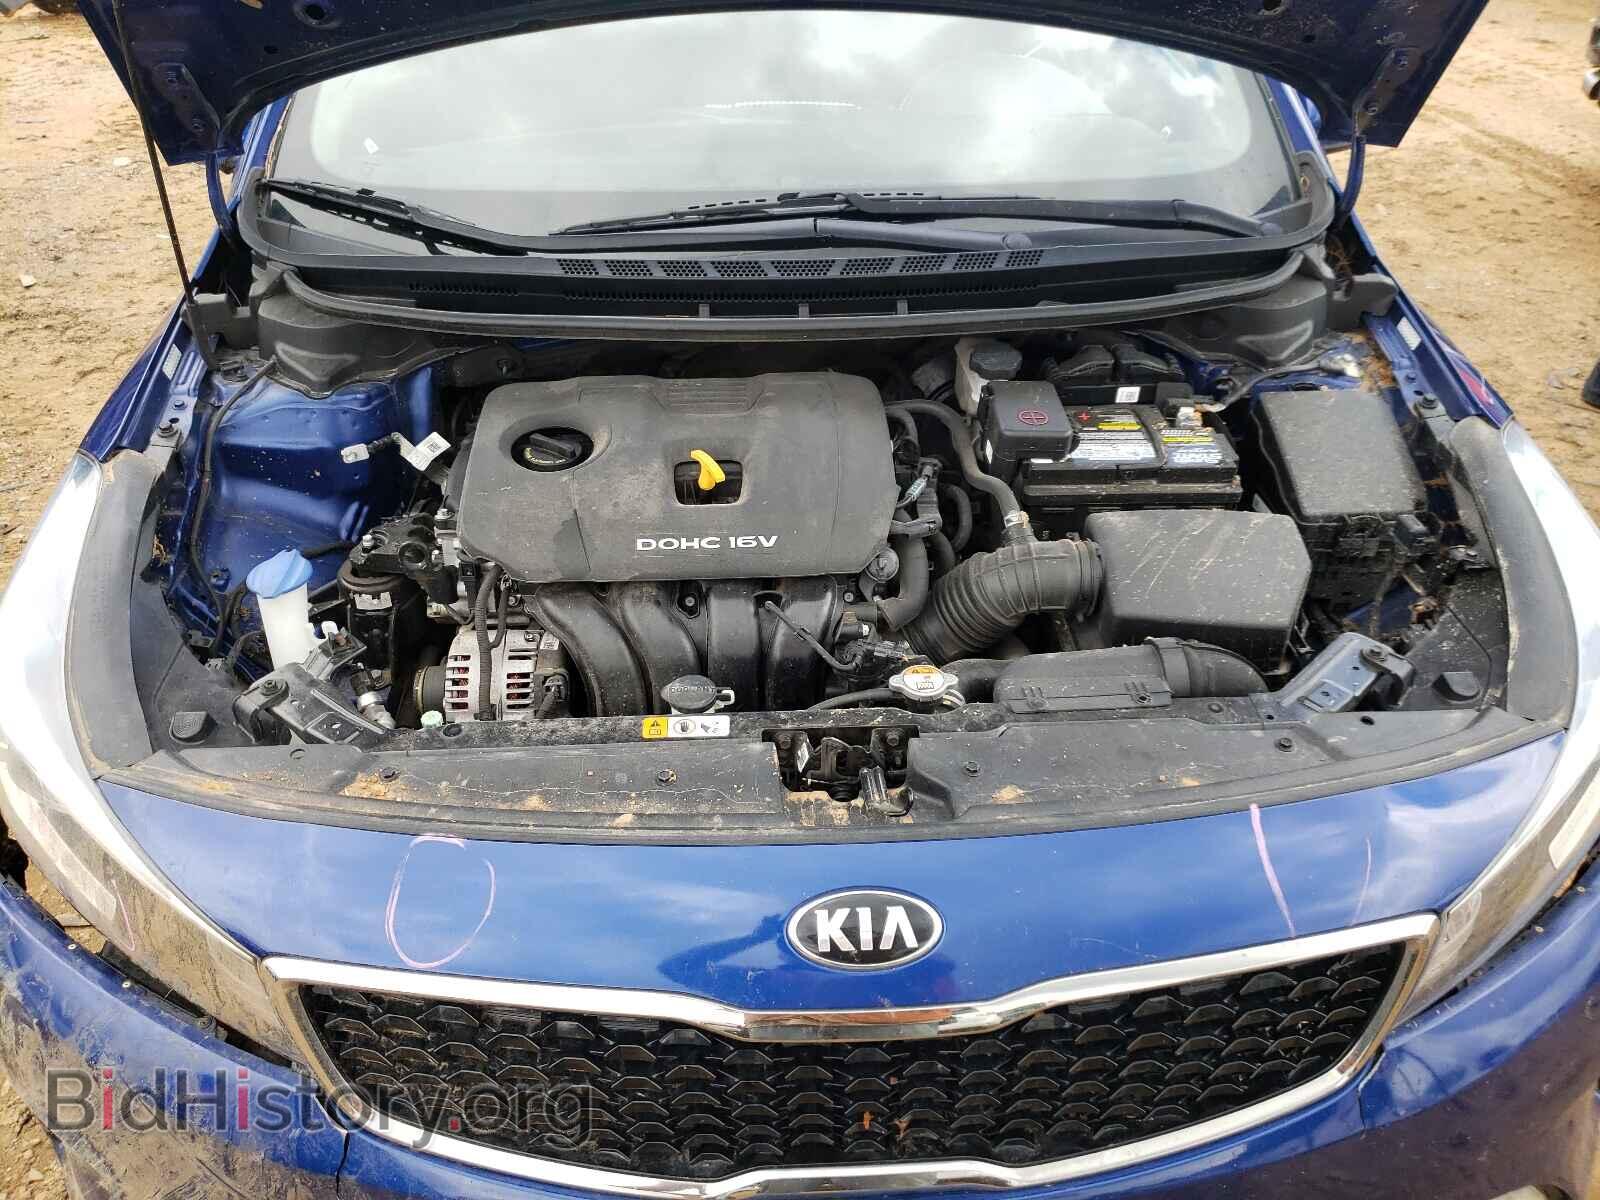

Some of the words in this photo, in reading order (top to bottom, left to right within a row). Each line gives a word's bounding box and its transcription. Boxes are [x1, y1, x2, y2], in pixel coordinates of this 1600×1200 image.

[636, 536, 721, 551] DOHC
[729, 535, 778, 549] 16V
[814, 905, 919, 953] KIA
